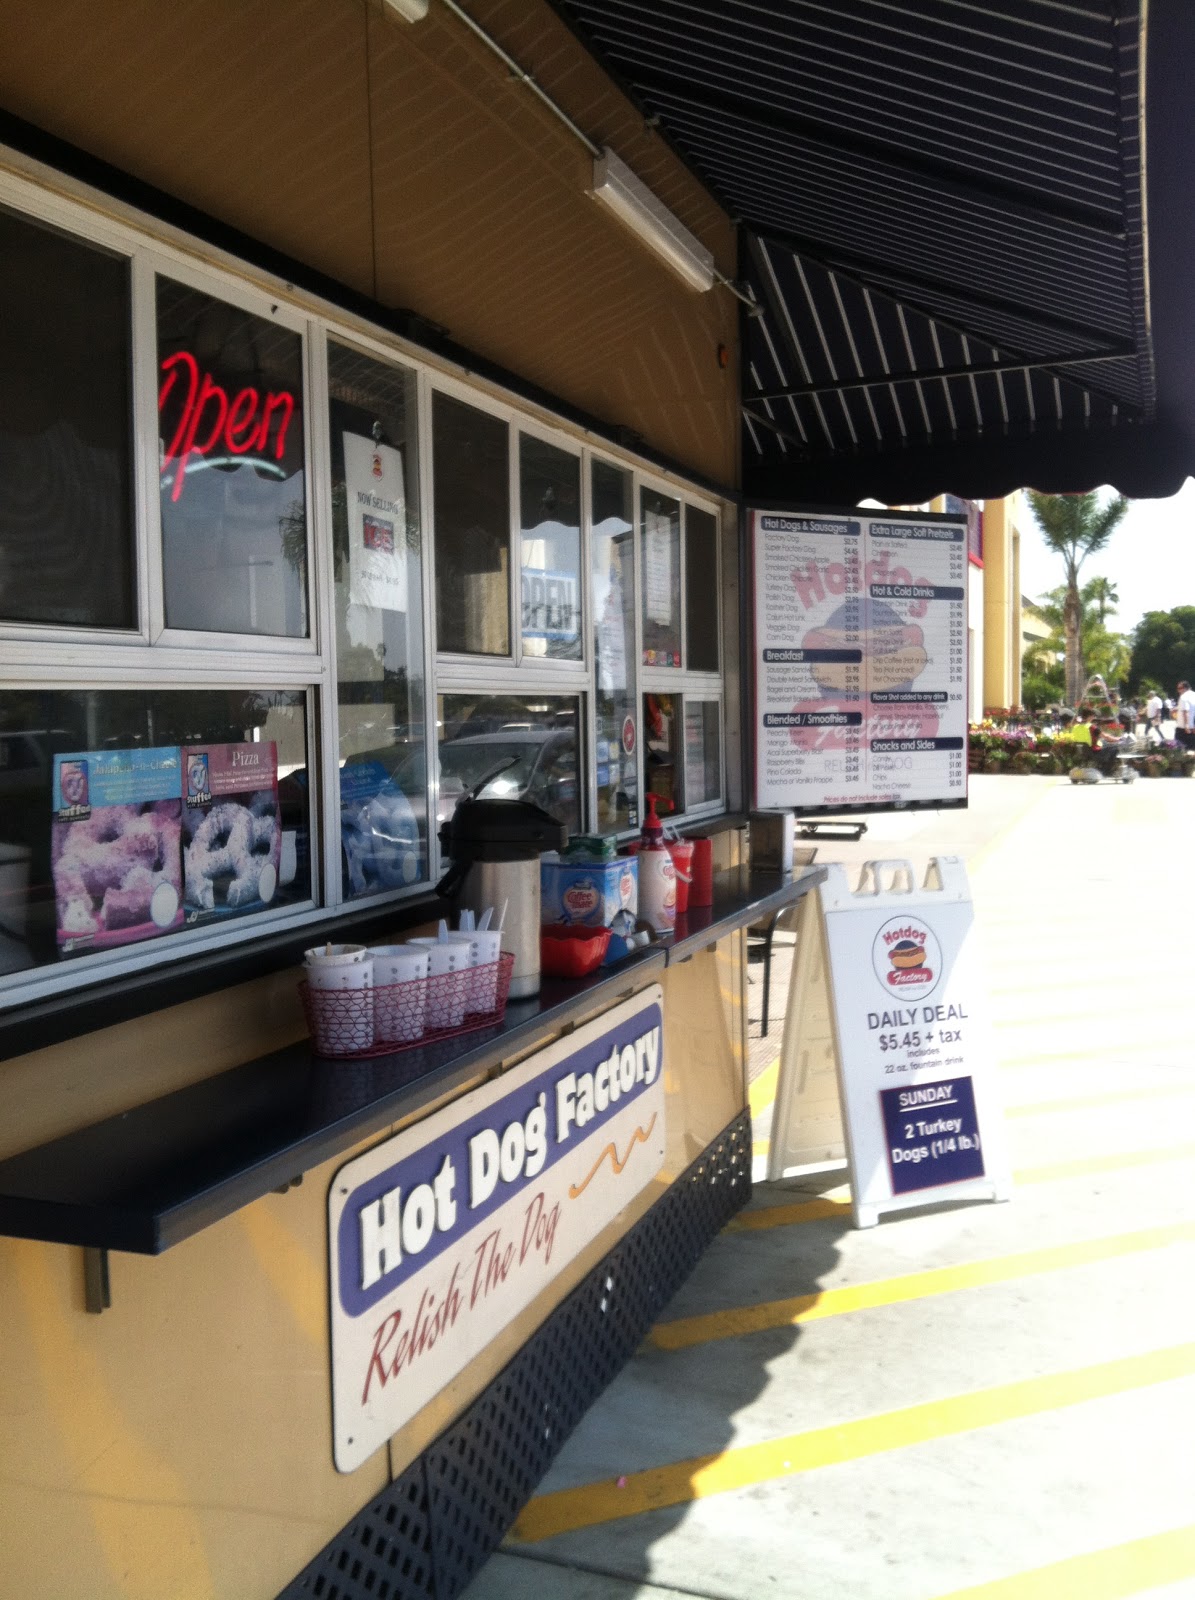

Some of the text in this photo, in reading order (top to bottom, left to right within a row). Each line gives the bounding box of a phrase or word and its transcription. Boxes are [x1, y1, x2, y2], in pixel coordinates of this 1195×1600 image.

[159, 350, 294, 502] Open
[357, 491, 398, 514] NOW SELLING
[764, 518, 848, 534] Hot Dogs & Sausages
[871, 525, 954, 539] Extra Large Soft Pretzels
[787, 534, 800, 543] Dog
[783, 585, 796, 593] Dog
[872, 586, 934, 597] Hot & Cold Drinks
[782, 594, 795, 602] Dog
[786, 604, 798, 613] Dog
[766, 623, 800, 632] Veggie Dog
[782, 634, 795, 642] Dog
[767, 650, 804, 660] Breakfast
[767, 666, 791, 674] Sausage
[767, 686, 783, 694] Bagel
[767, 714, 848, 725] Blended / Smoothies
[872, 740, 935, 751] Snacks and Sides
[232, 752, 259, 766] Pizza
[567, 891, 592, 903] Coffee
[882, 925, 927, 945] Hotdog
[892, 971, 927, 985] Factory
[867, 1004, 968, 1030] DAILY DEAL
[879, 1029, 962, 1052] $5.45 + tax
[907, 1047, 940, 1058] includes
[884, 1064, 894, 1074] 22
[910, 1060, 942, 1070] fountain
[945, 1056, 964, 1065] drink
[899, 1085, 953, 1106] SUNDAY
[904, 1118, 962, 1139] 2 Turkey
[892, 1133, 980, 1163] Dogs (1/4 lb.)
[358, 1024, 660, 1291] Hot Dog Factory
[362, 1191, 562, 1406] Relish The Dog
